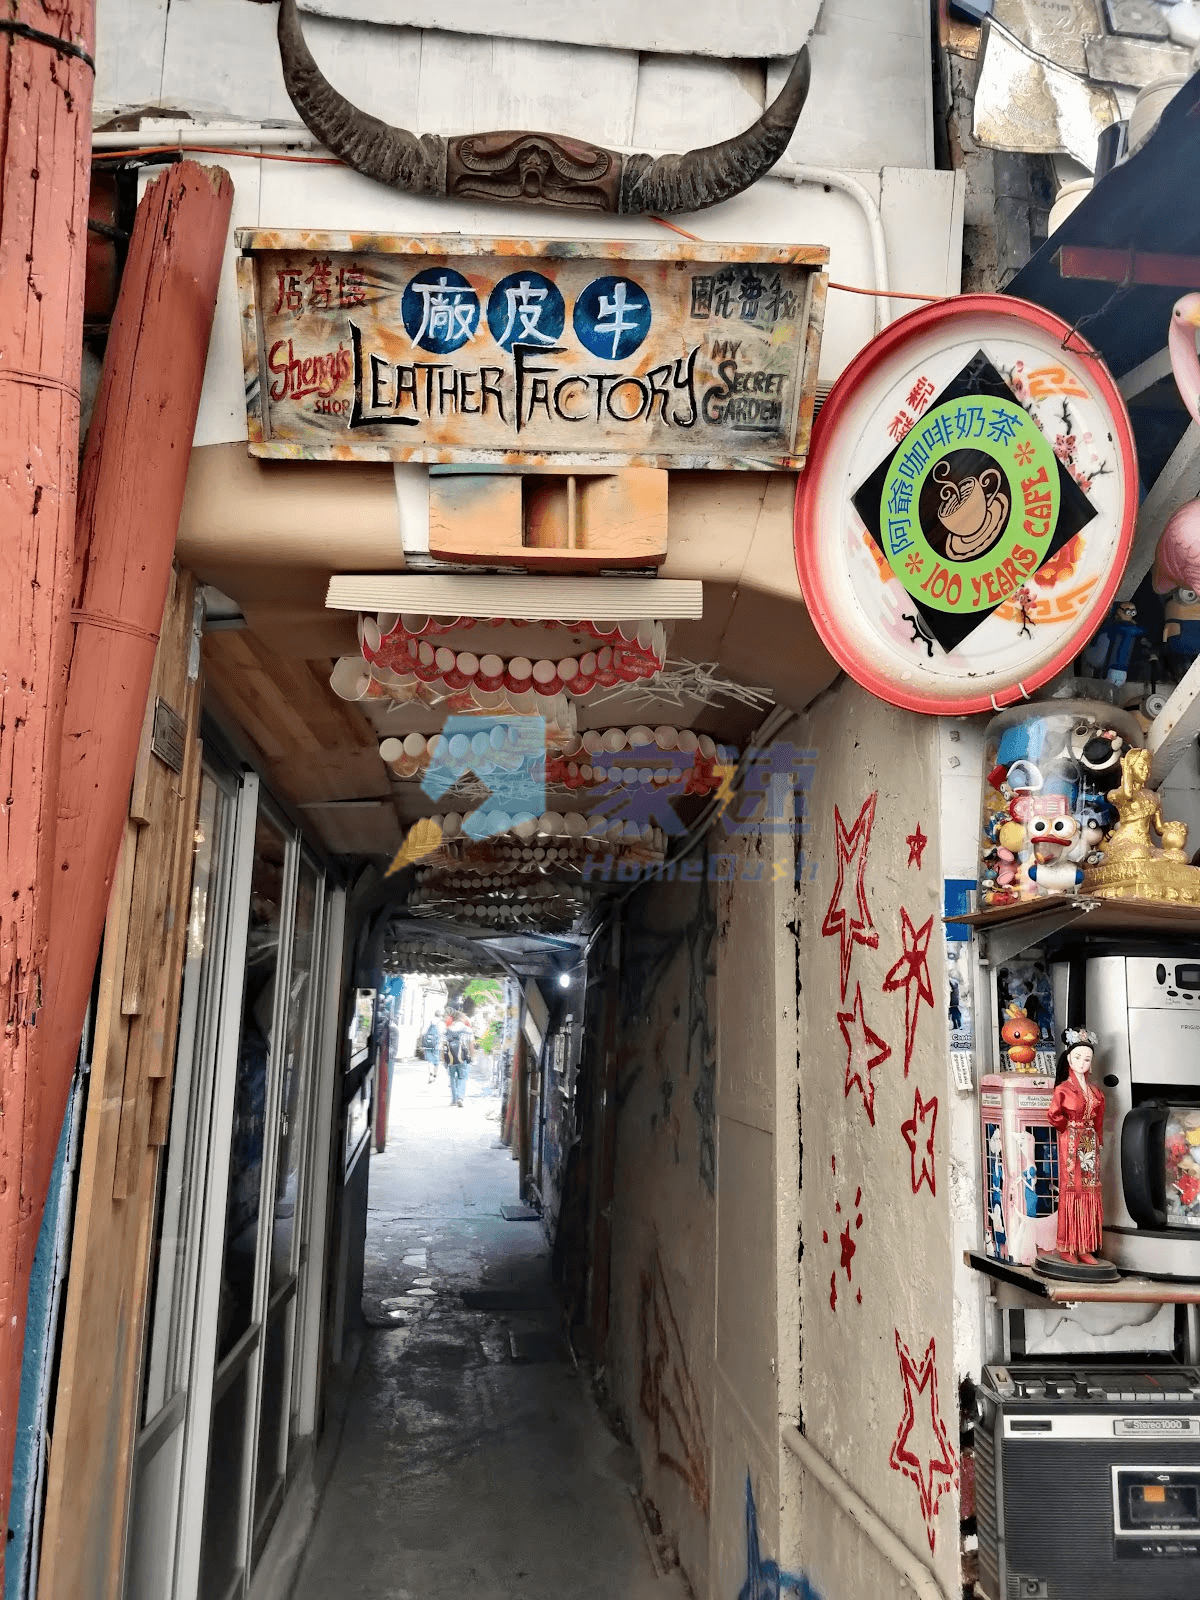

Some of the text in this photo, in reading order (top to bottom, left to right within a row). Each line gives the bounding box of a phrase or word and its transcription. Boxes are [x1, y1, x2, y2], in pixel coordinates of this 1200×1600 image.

[712, 340, 742, 360] MY
[348, 318, 508, 429] LEATHER
[714, 360, 788, 398] SECRET
[314, 400, 349, 414] SHOP
[702, 386, 782, 425] GARDEN
[920, 466, 1052, 606] 100 YEARS CAFE
